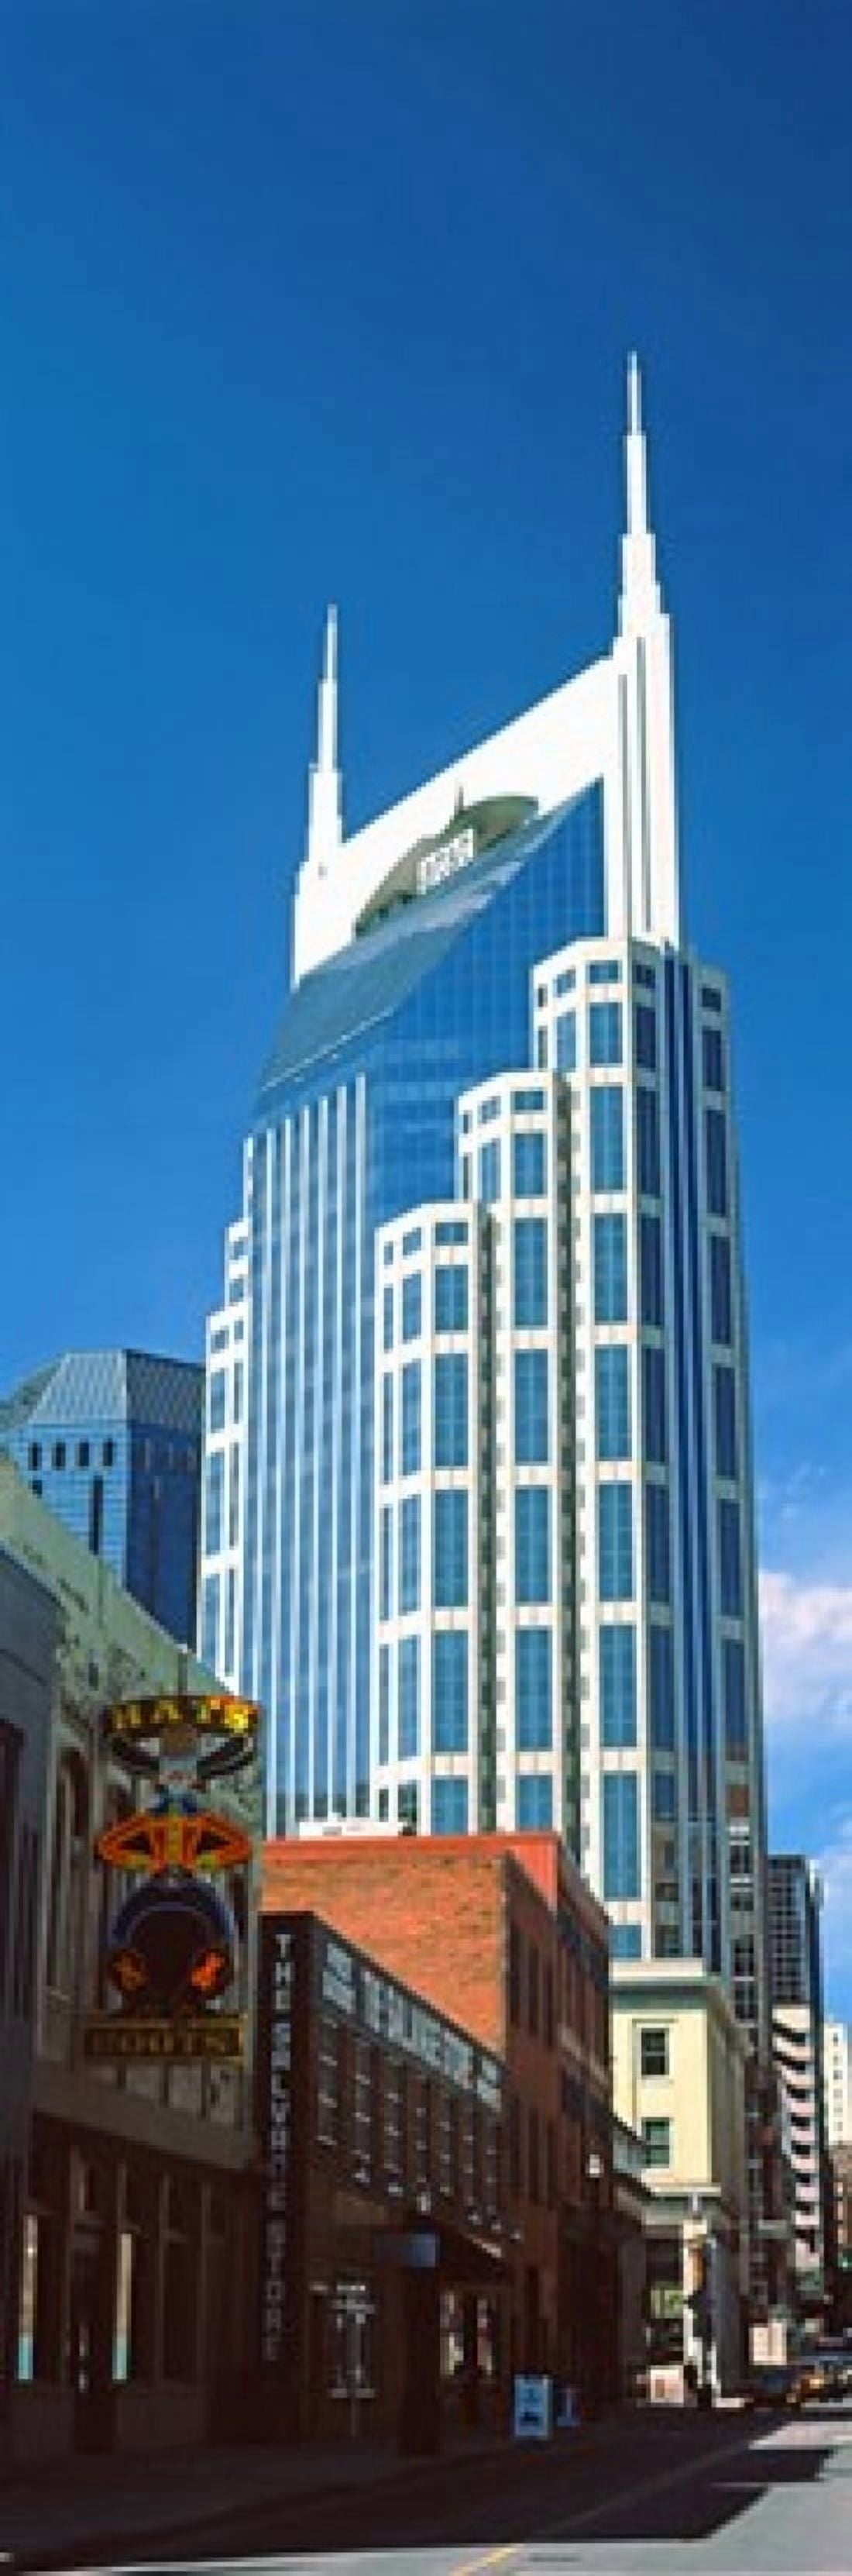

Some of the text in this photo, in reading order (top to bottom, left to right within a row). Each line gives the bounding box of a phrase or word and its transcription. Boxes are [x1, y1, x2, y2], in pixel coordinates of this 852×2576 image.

[112, 1700, 249, 1733] HATS
[272, 1933, 294, 2011] THE
[91, 2030, 231, 2055] BOOTS
